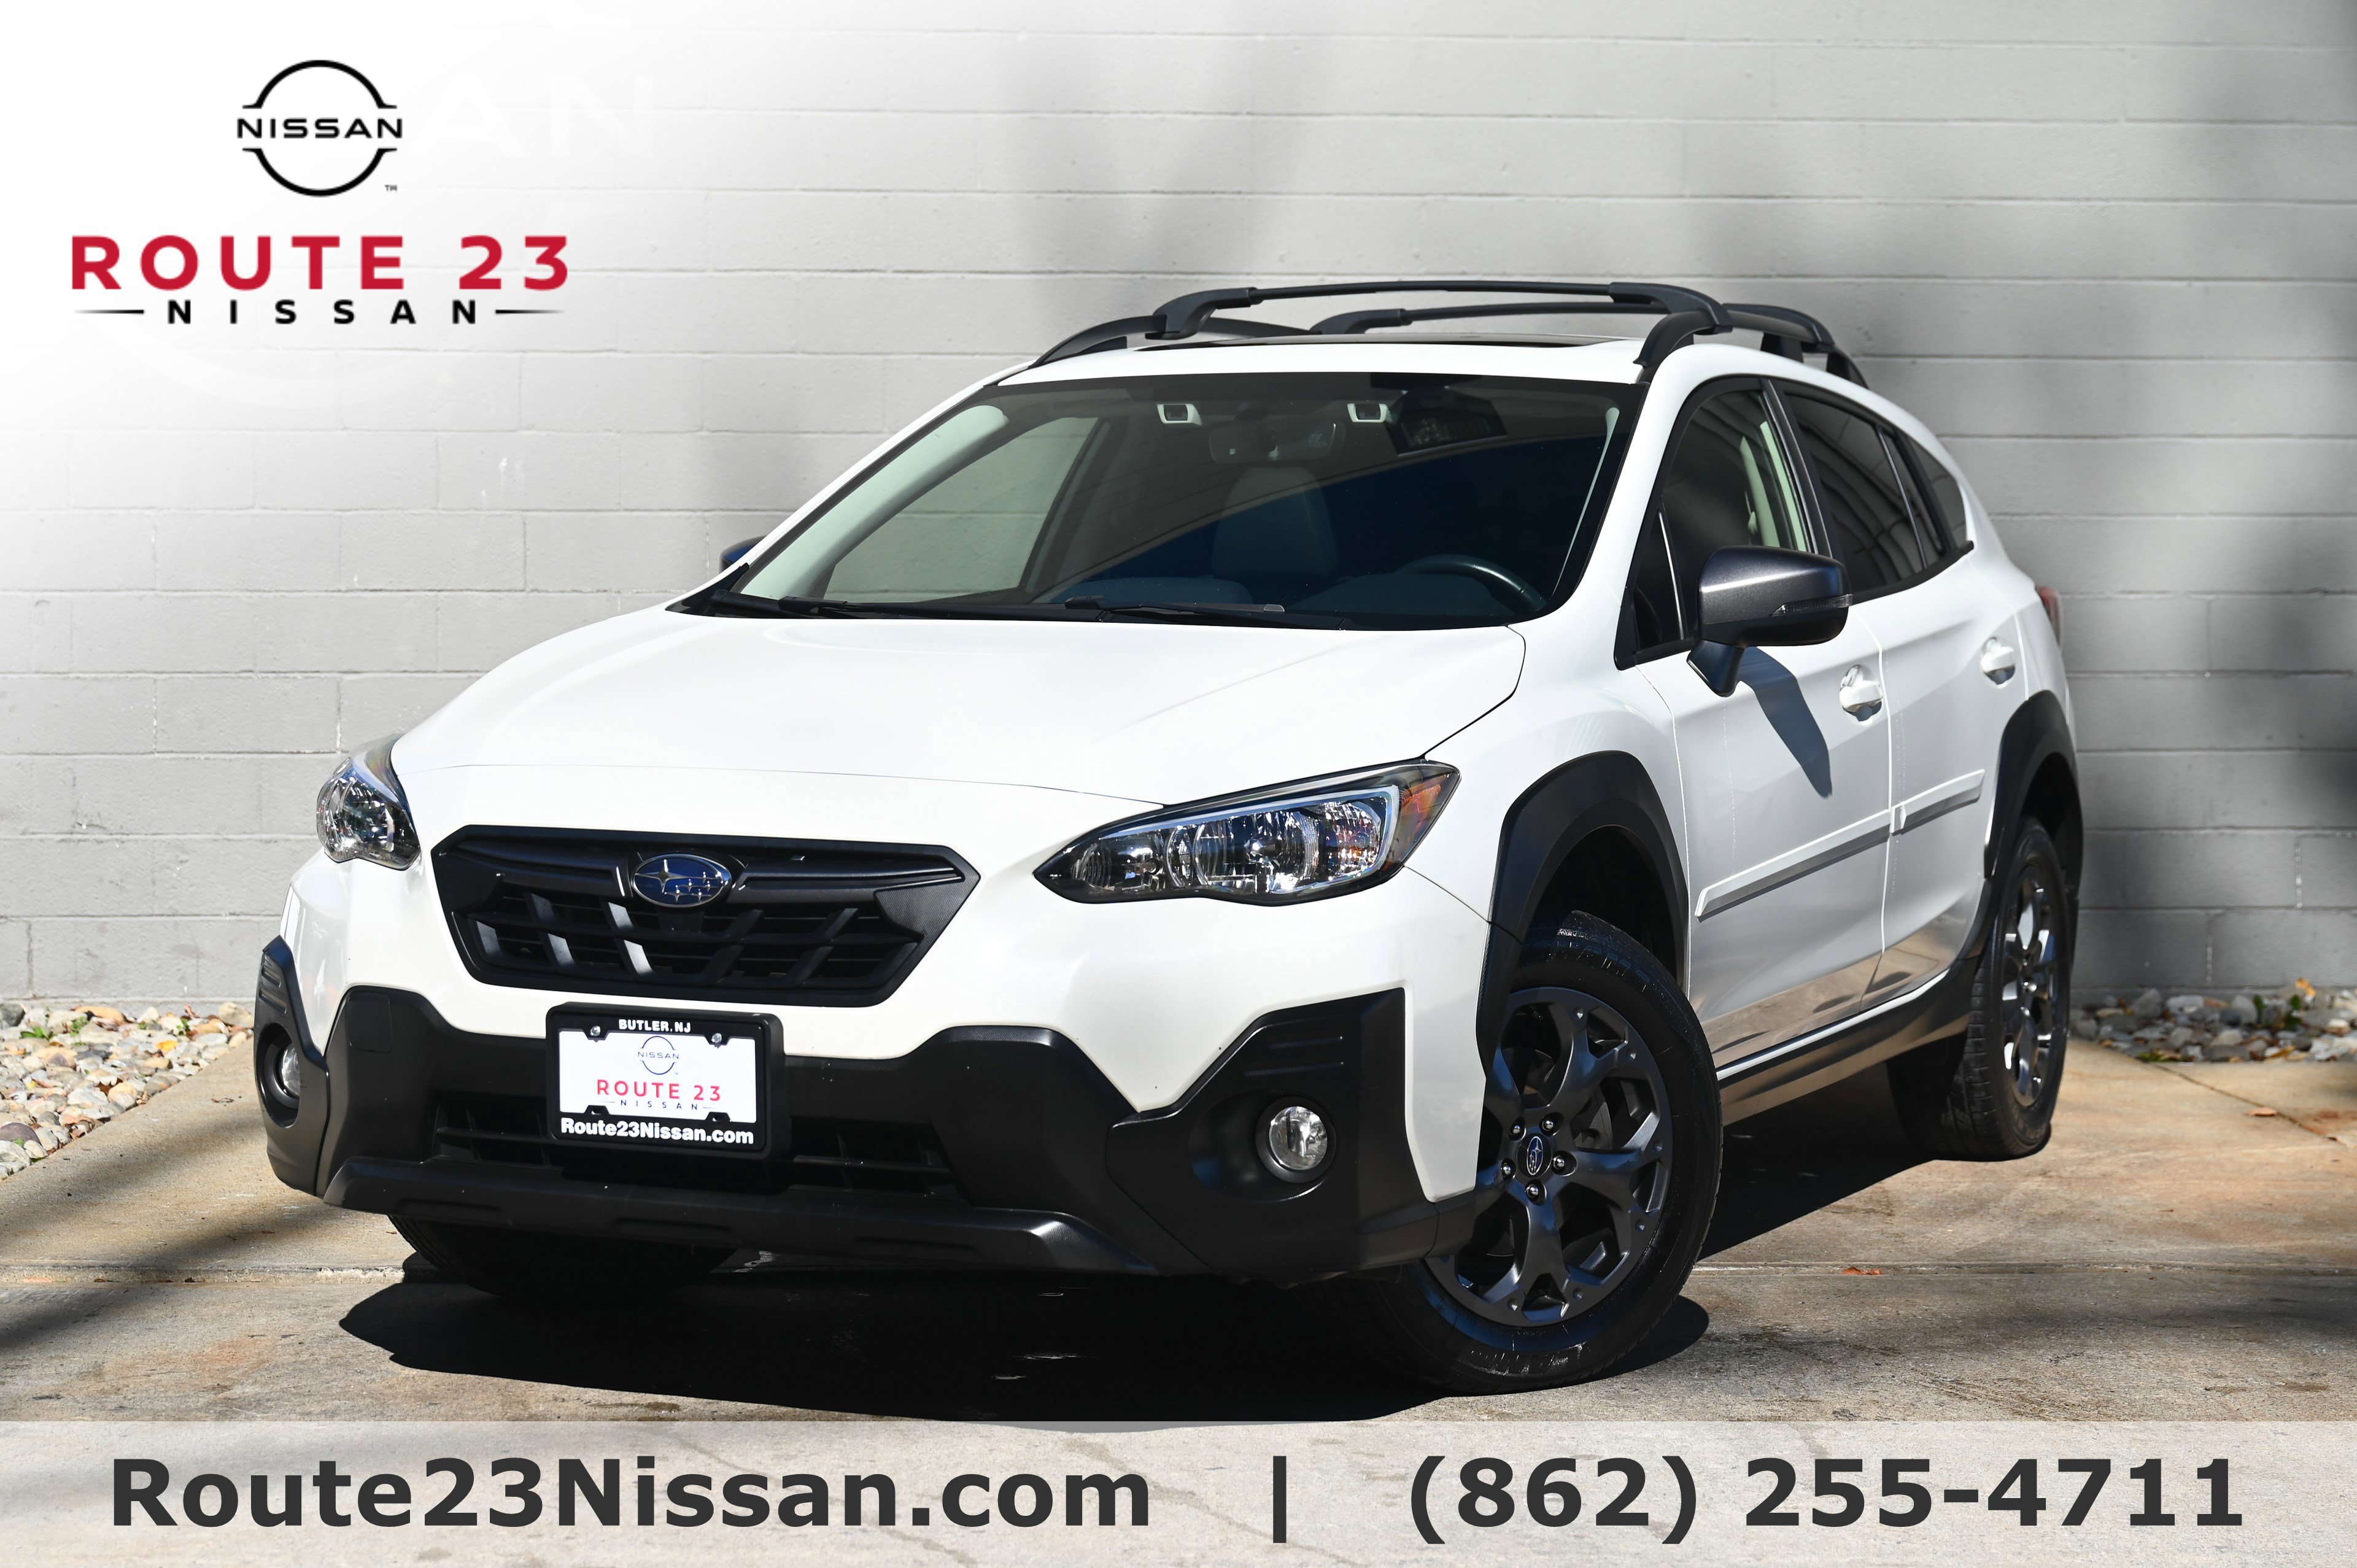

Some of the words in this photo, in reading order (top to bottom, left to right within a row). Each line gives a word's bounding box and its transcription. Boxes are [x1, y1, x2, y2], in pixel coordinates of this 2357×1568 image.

[674, 1021, 691, 1033] NJ
[597, 1079, 680, 1099] ROUTE
[693, 1084, 721, 1102] 23
[620, 1099, 698, 1110] NISSAN
[560, 1117, 754, 1145] Route23Nissan.com
